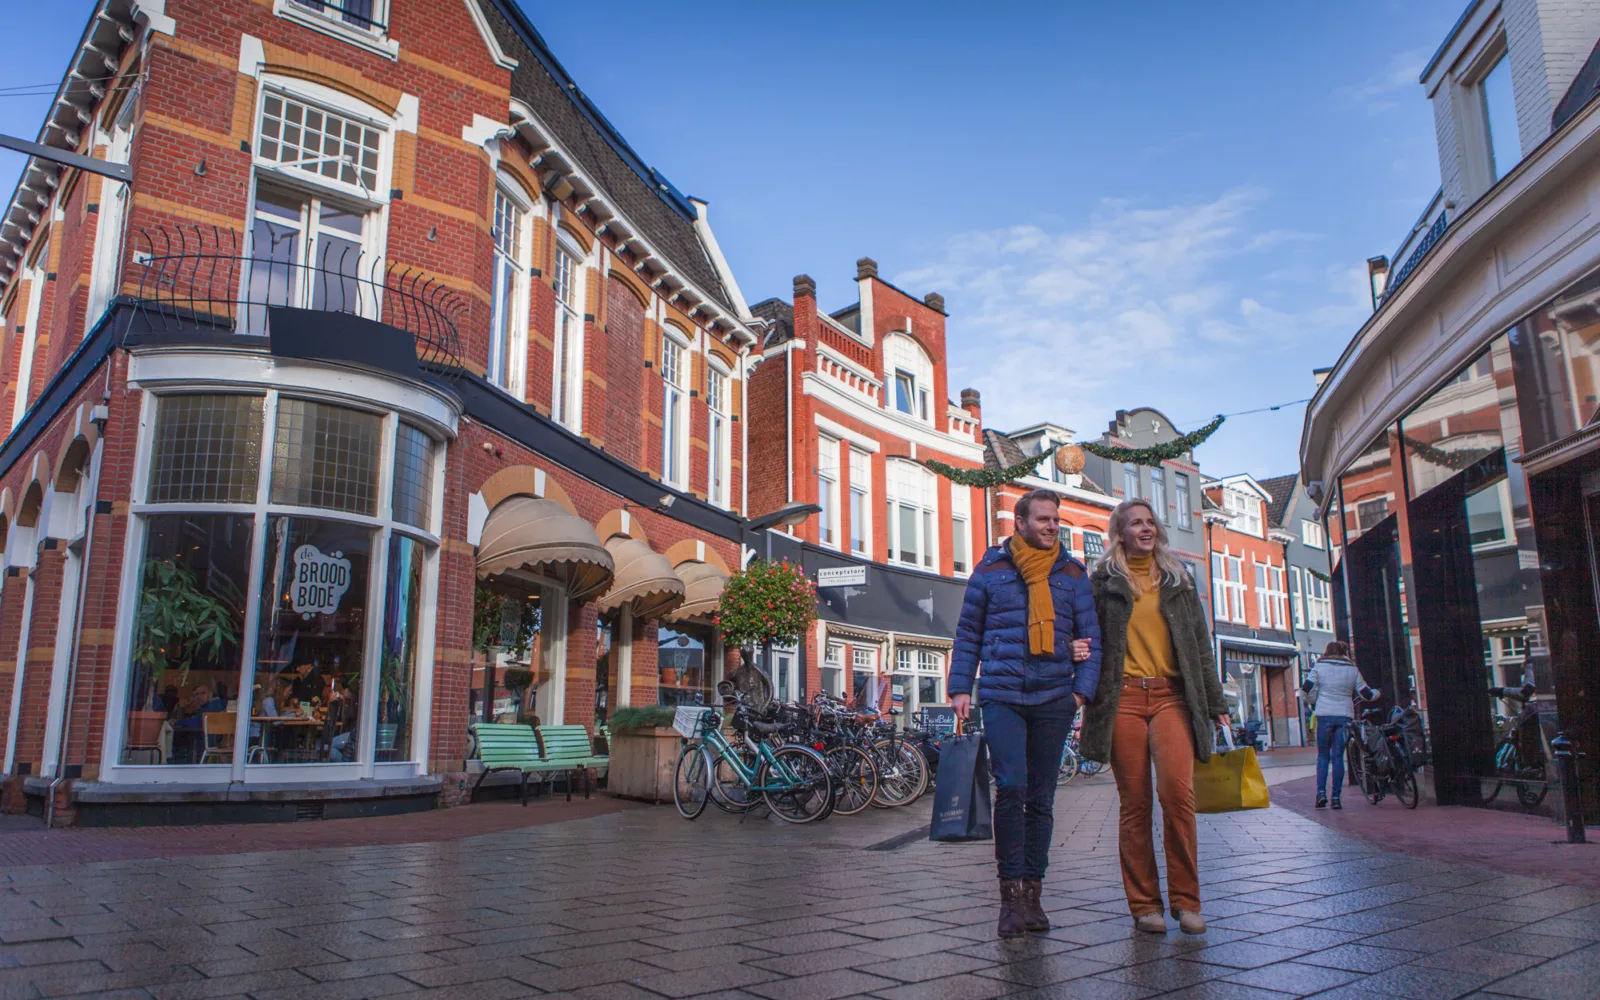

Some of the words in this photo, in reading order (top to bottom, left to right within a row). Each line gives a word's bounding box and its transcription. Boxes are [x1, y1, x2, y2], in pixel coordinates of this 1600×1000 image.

[301, 548, 313, 561] de
[299, 562, 346, 586] BROOD
[819, 569, 865, 577] conceptstore
[297, 584, 335, 608] BODE
